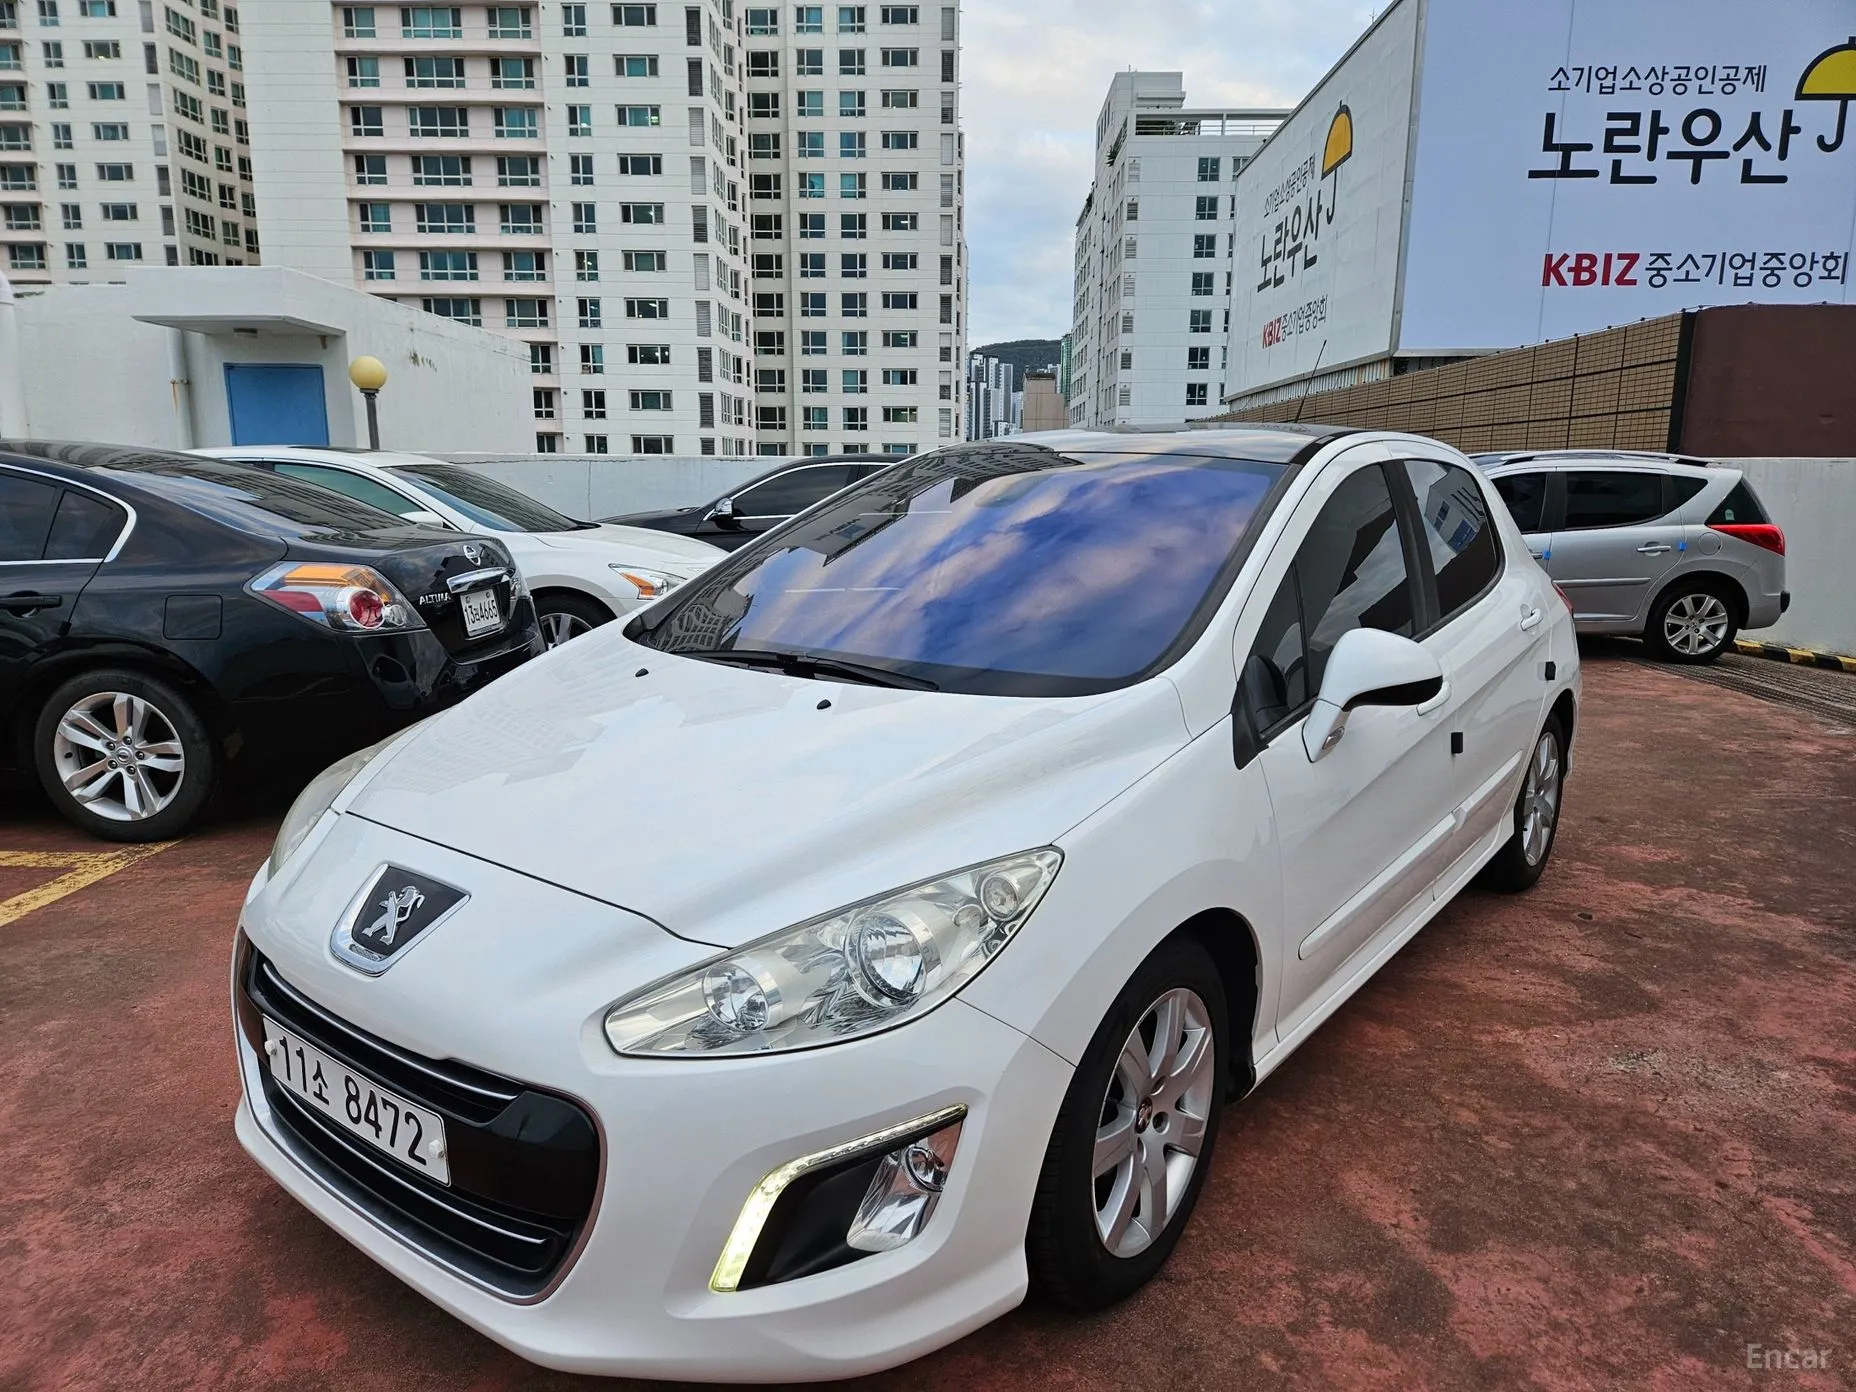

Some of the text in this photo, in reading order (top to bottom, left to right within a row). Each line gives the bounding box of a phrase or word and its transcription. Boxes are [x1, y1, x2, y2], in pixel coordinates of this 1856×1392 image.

[1547, 64, 1768, 96] 소기업소상공인공제
[1528, 108, 1802, 185] 노란우산
[1257, 189, 1323, 293] 노란우산
[1645, 251, 1849, 288] 중소기업중앙회
[419, 592, 452, 606] ALTIMA
[278, 1035, 427, 1166] 11소 8472
